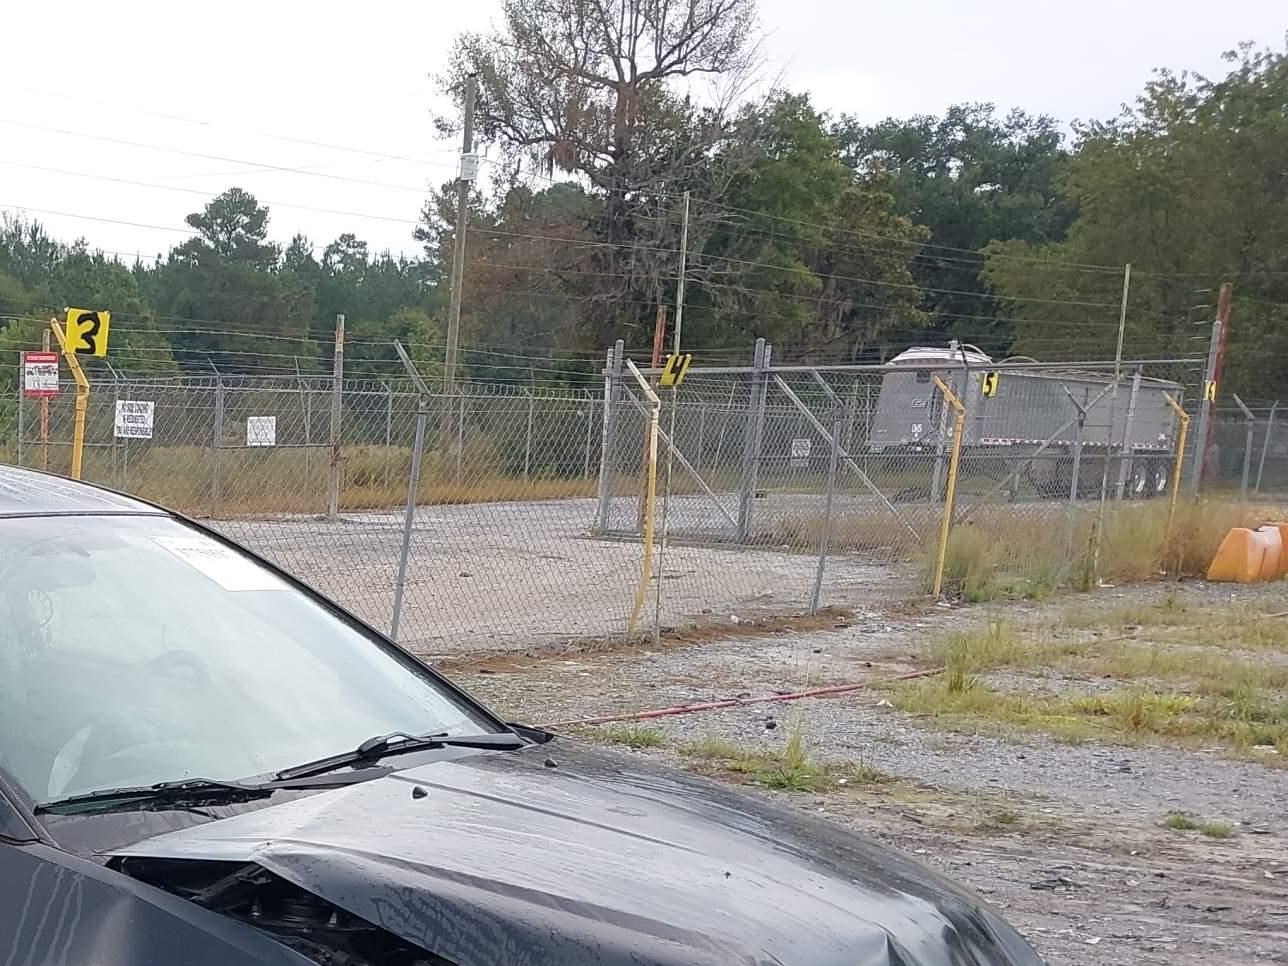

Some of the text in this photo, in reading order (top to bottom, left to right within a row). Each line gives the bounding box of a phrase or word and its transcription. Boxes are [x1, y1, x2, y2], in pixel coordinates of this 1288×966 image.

[75, 312, 101, 354] 3
[670, 356, 686, 385] 4
[982, 372, 995, 400] 5
